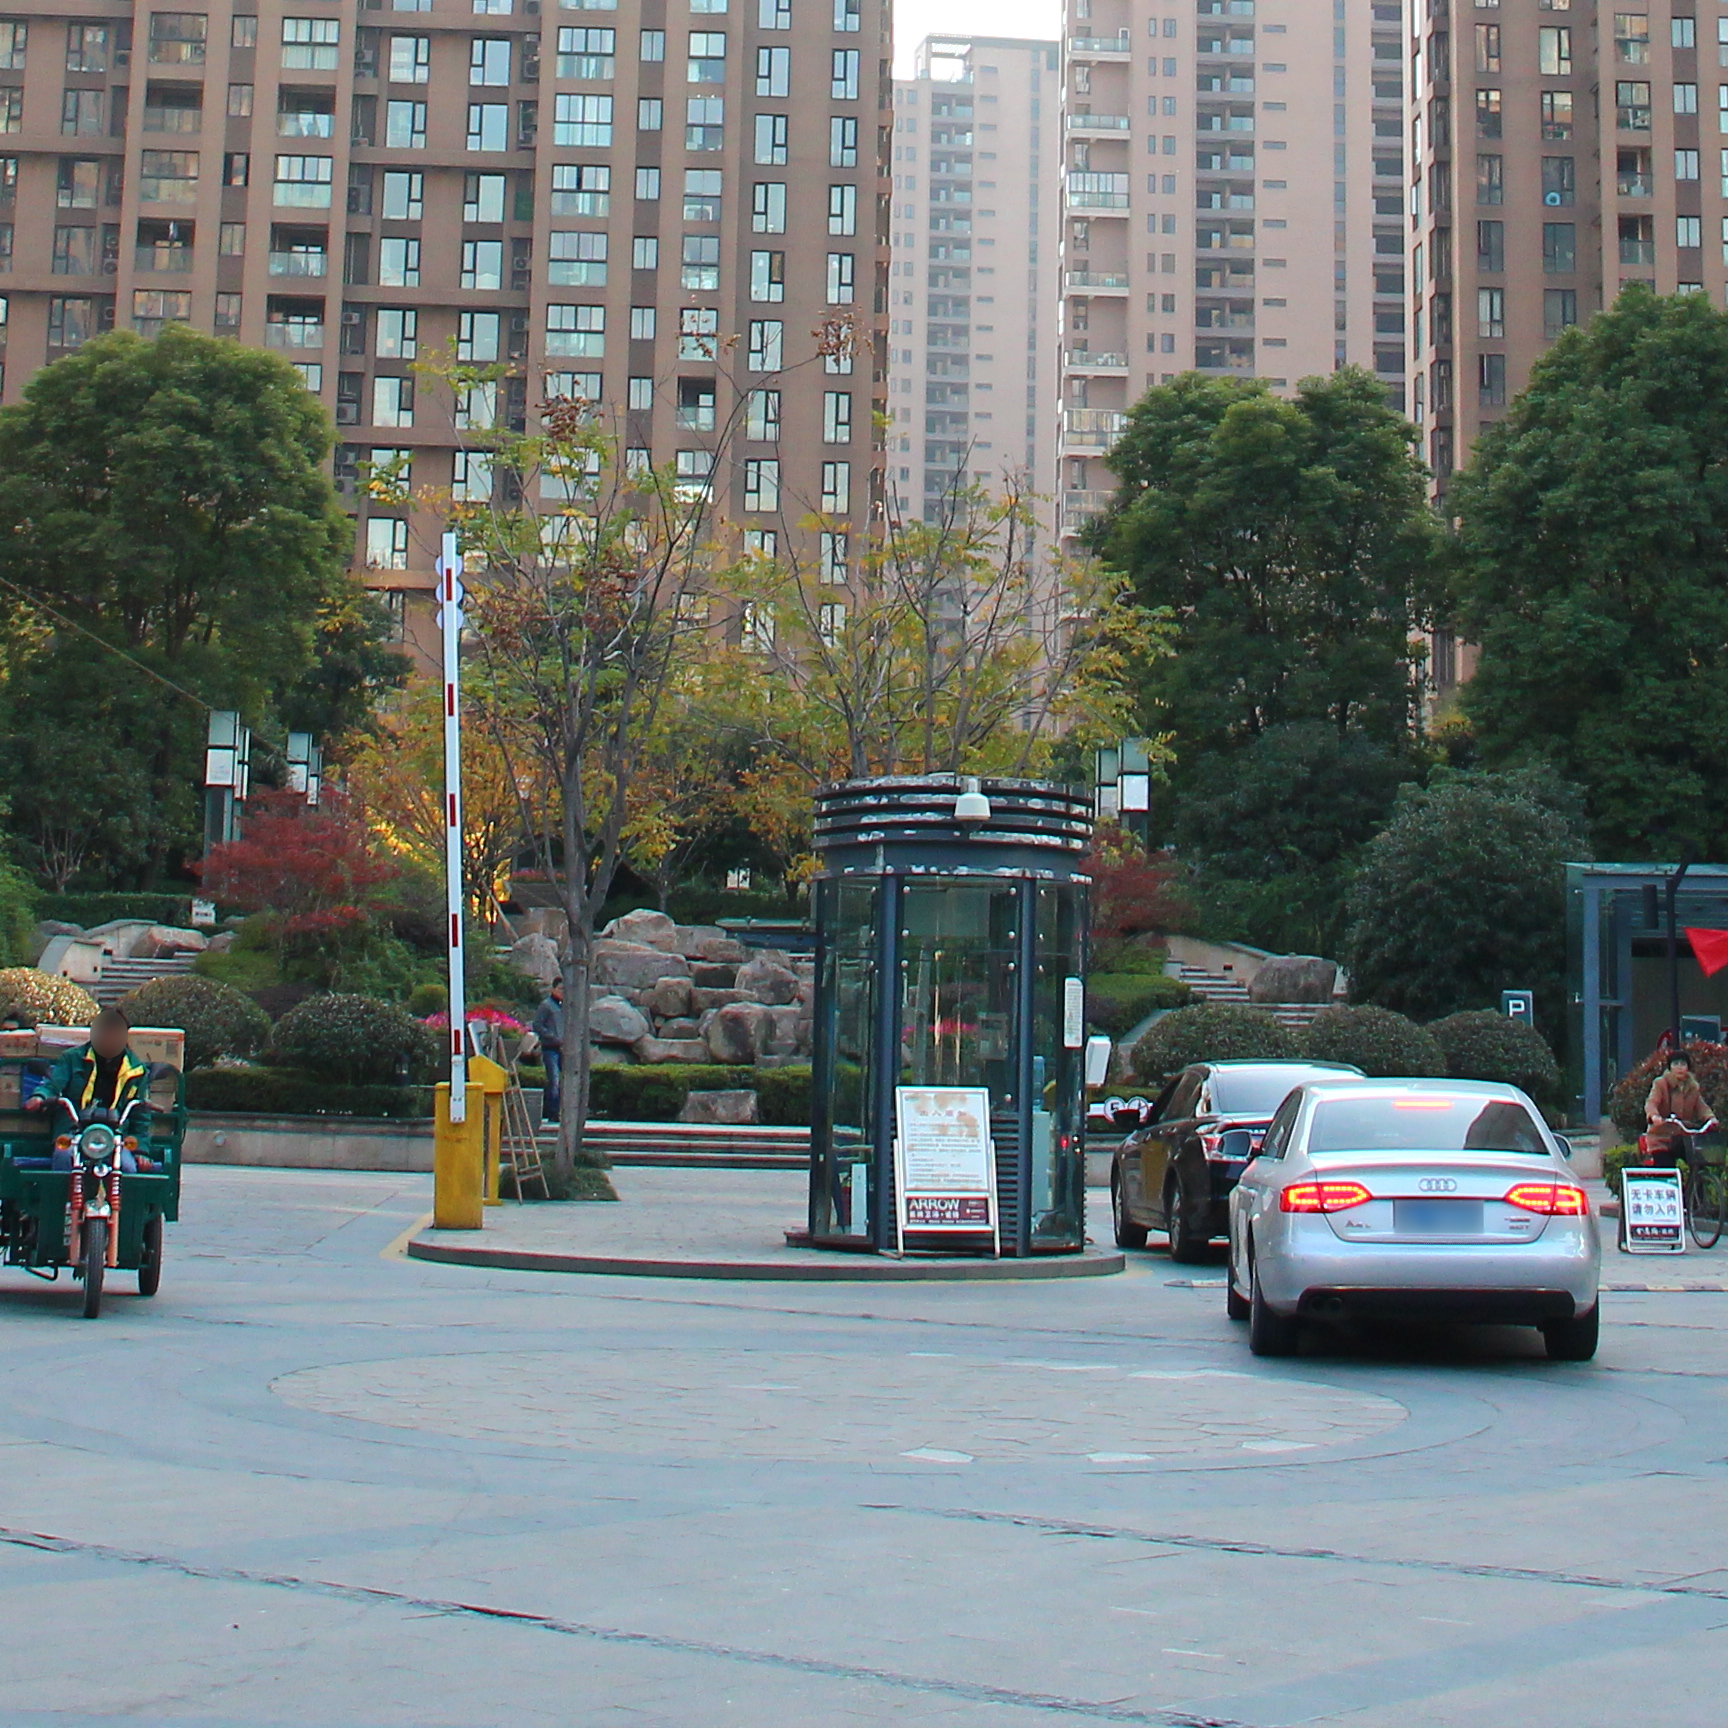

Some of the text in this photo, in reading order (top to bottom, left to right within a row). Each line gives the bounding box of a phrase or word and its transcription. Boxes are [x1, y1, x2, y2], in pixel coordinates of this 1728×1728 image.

[1508, 999, 1526, 1018] P
[908, 1198, 961, 1211] ARROW
[1631, 1203, 1677, 1216] 请勿入内
